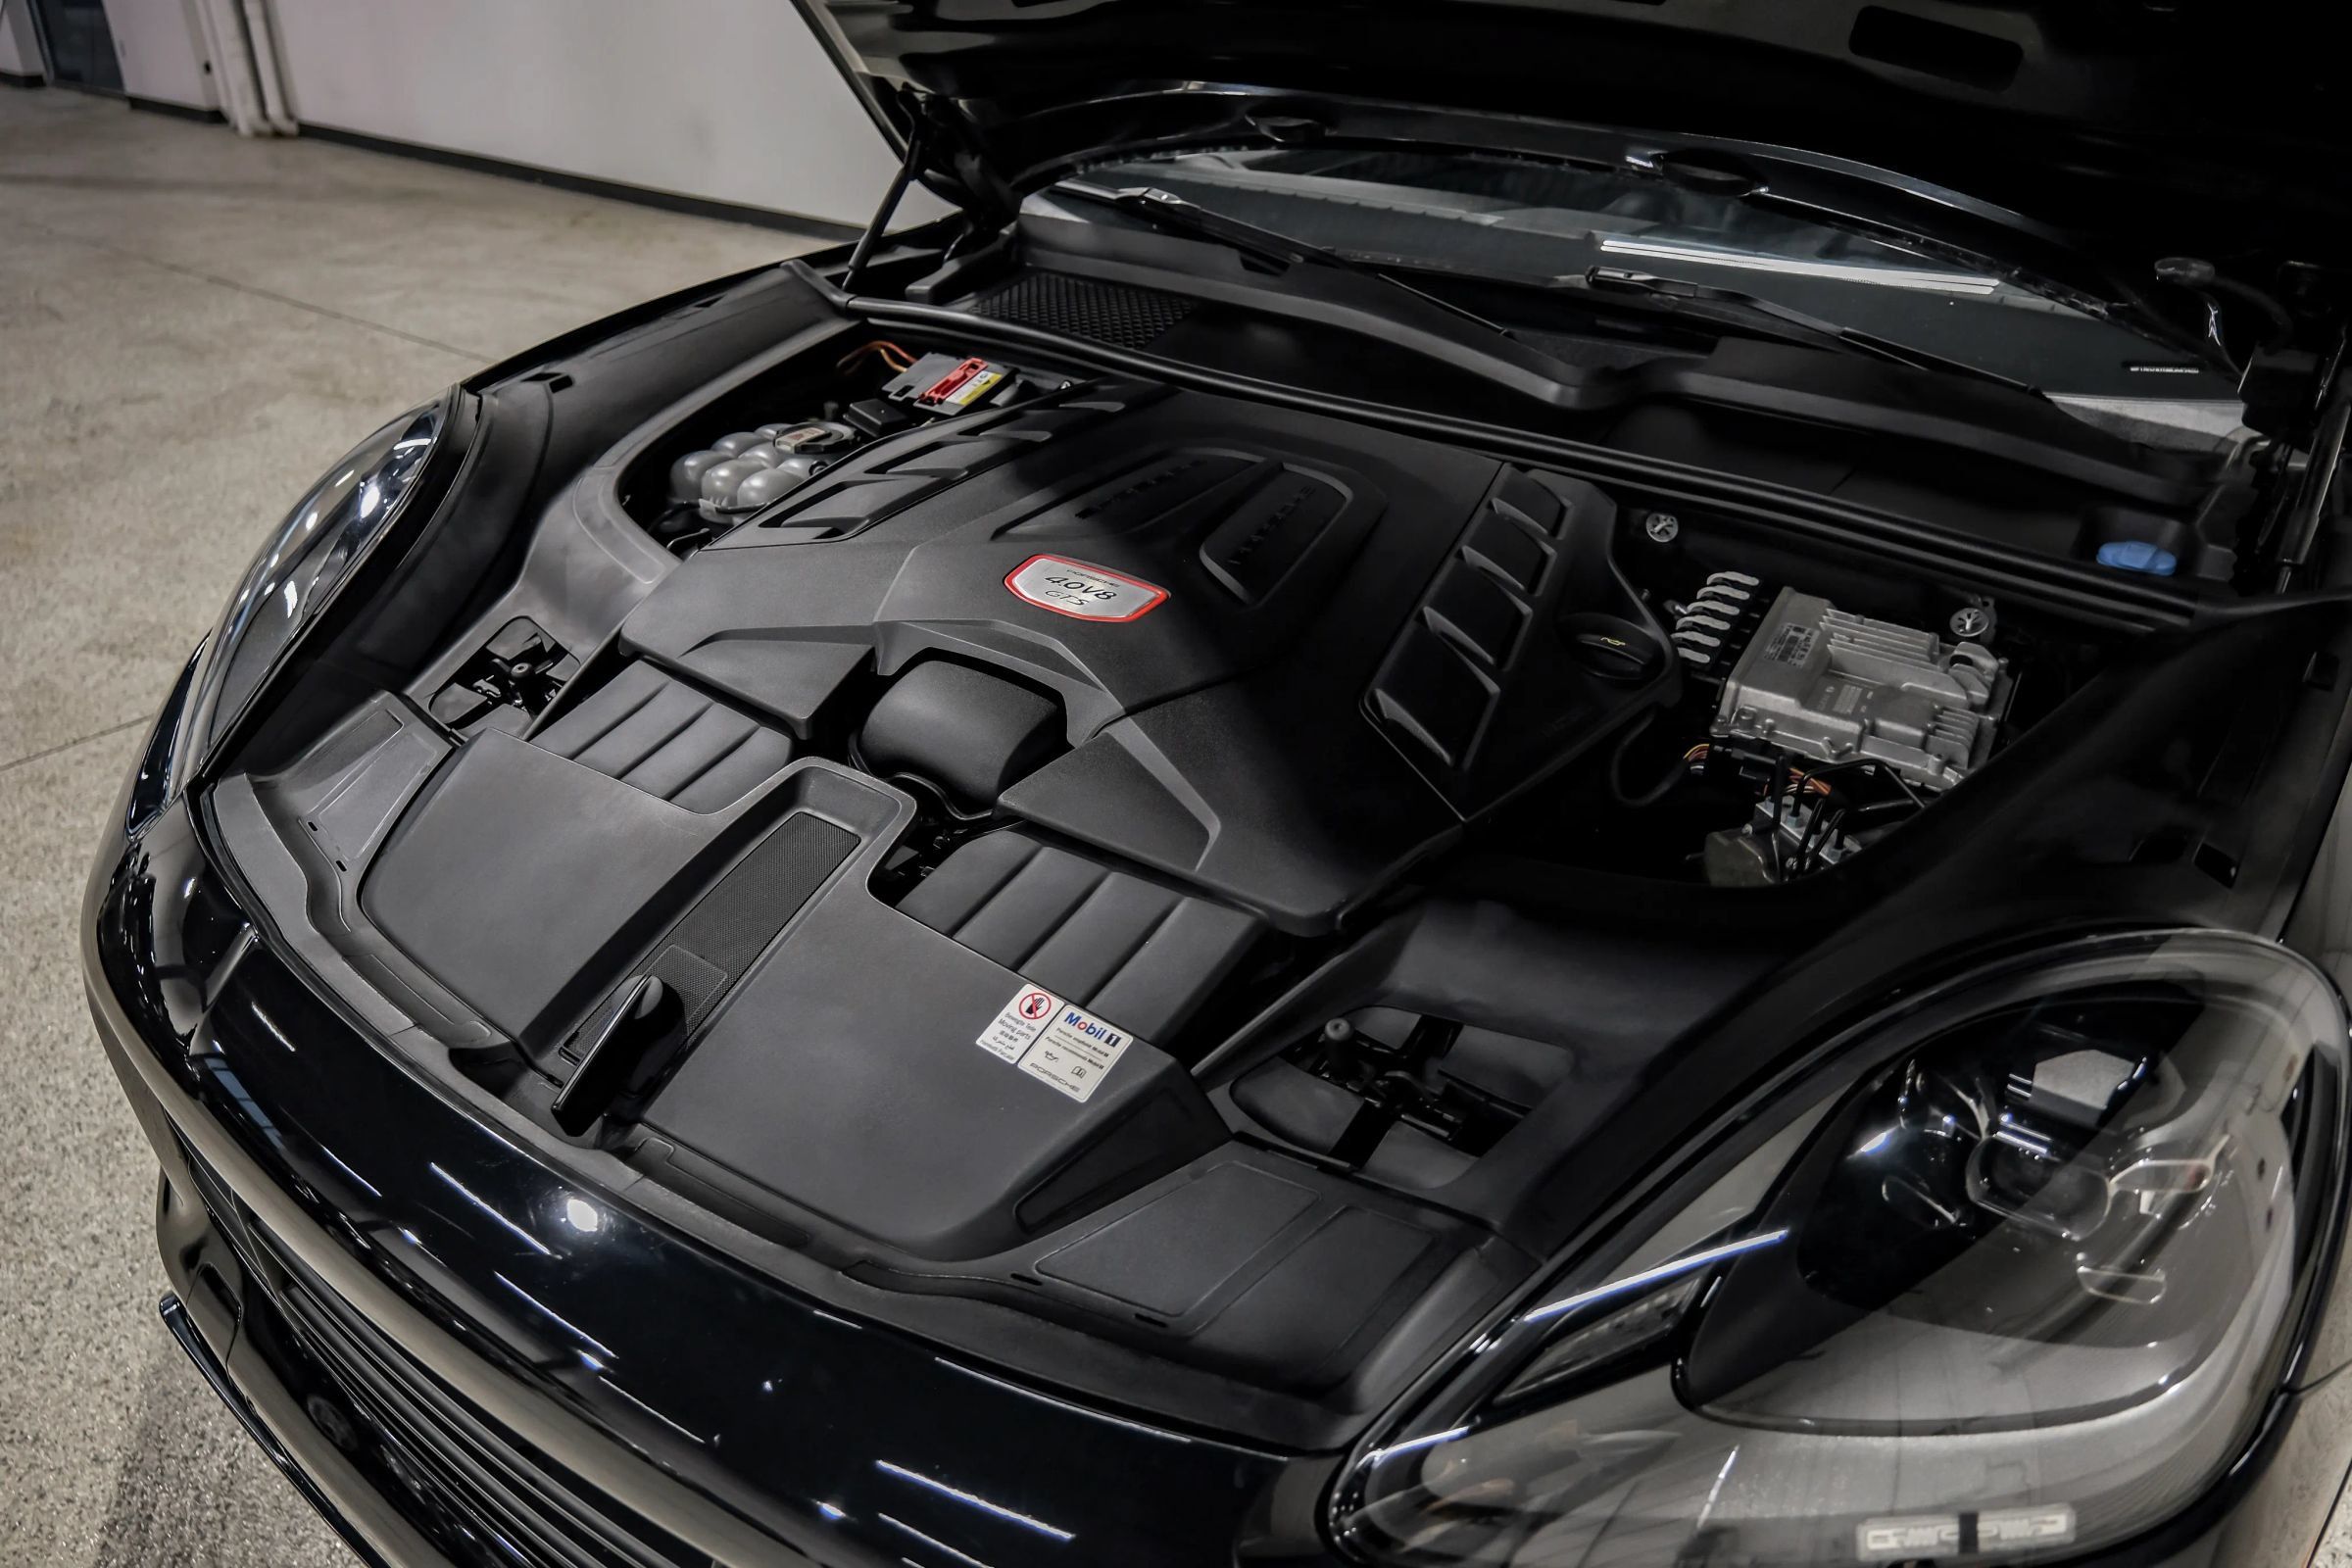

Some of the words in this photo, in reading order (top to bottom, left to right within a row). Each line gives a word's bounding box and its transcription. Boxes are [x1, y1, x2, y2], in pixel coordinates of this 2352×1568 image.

[1045, 590, 1089, 606] GTS
[998, 1019, 1017, 1032] Moving
[1015, 1030, 1031, 1040] parts
[1064, 1012, 1107, 1039] Mobil
[1106, 1034, 1119, 1046] 1
[1045, 1036, 1061, 1047] Porsche
[1030, 1063, 1080, 1092] PORSCHE
